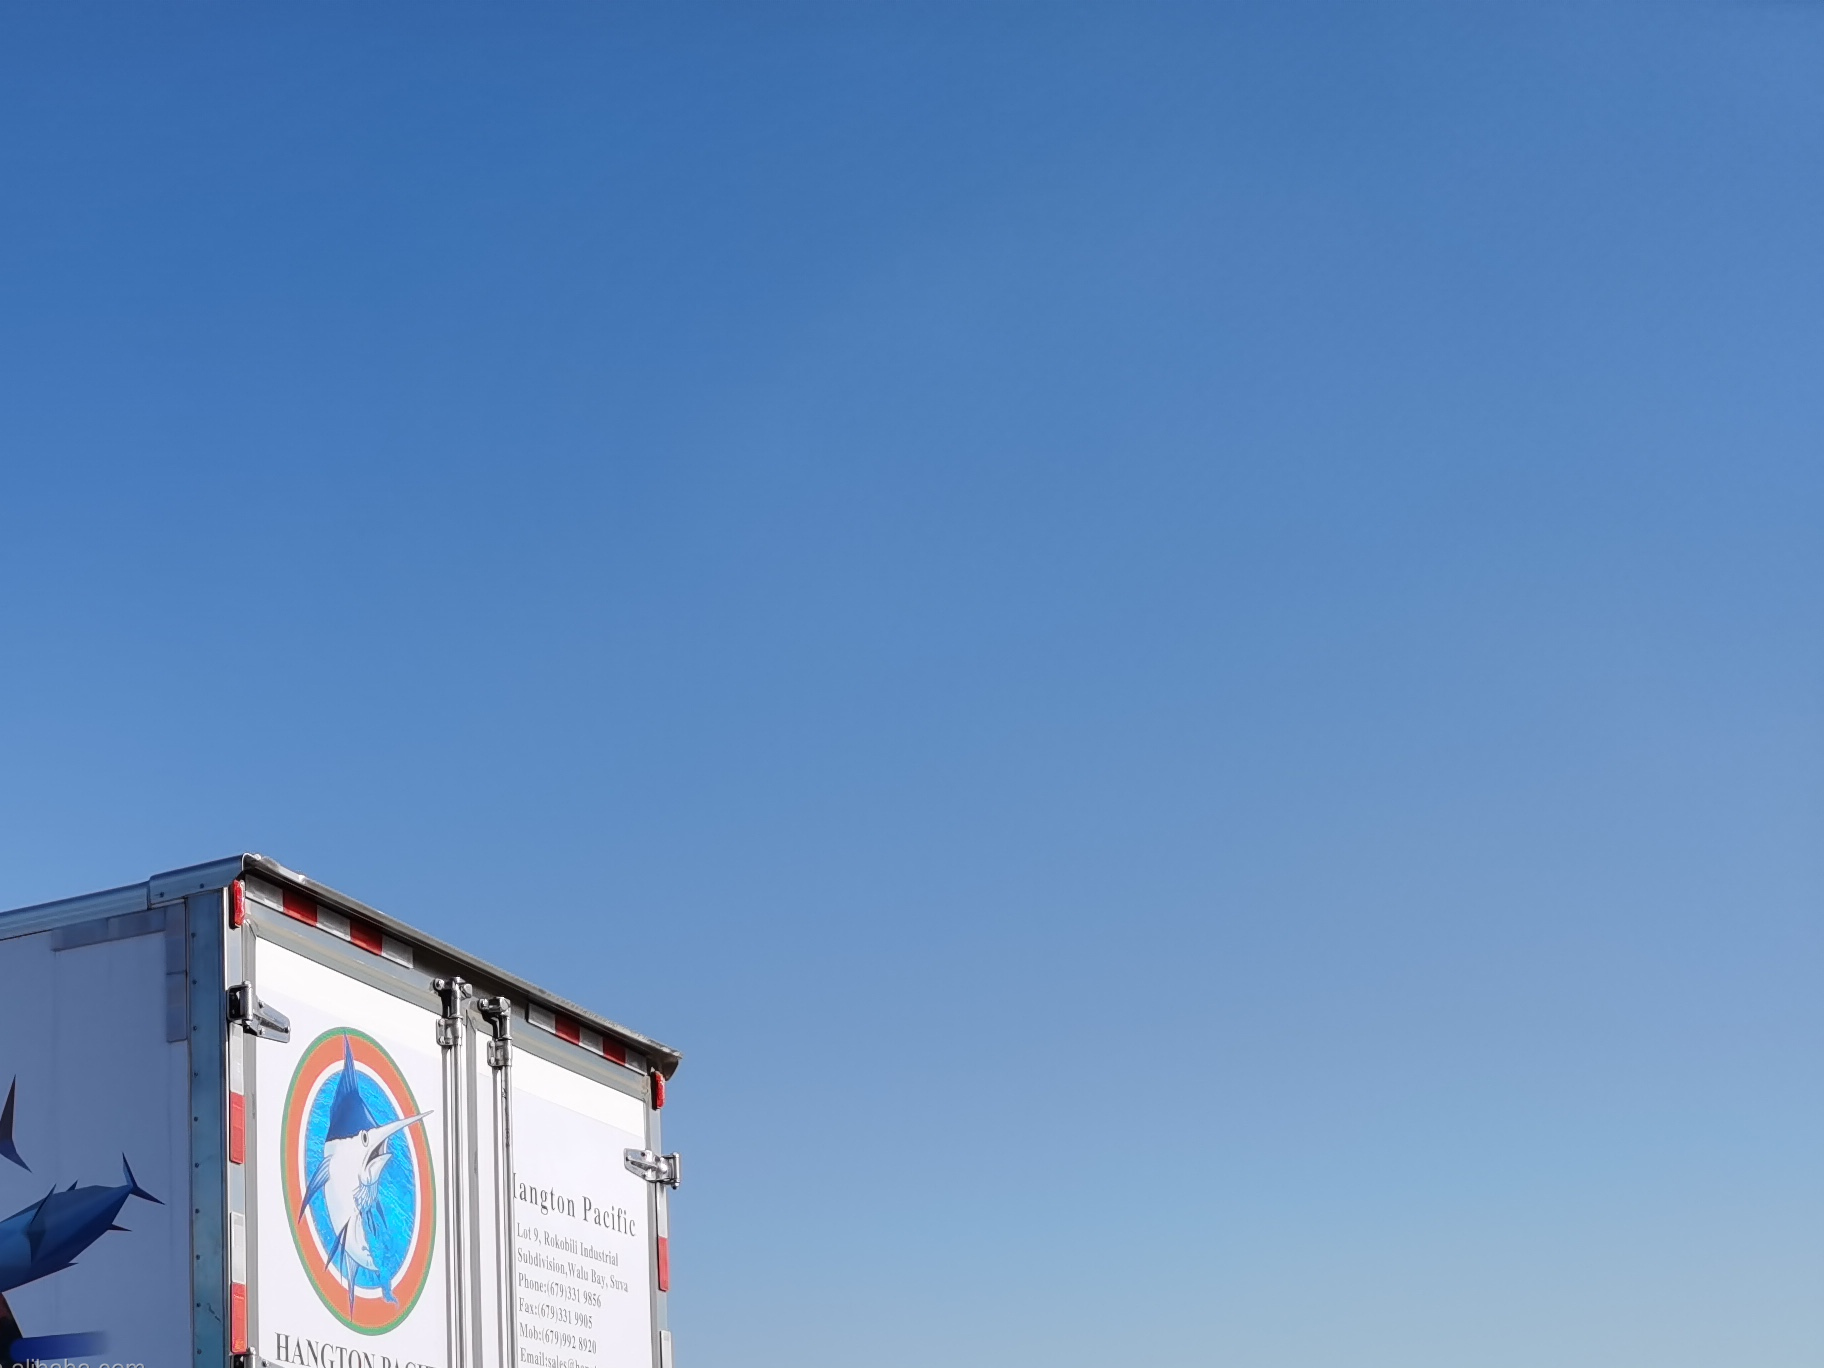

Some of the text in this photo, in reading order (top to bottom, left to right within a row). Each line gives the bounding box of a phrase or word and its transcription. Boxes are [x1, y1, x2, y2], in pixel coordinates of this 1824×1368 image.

[582, 1196, 636, 1236] Pacific
[517, 1222, 619, 1267] Lot 9, Rokobili Industrial
[591, 1269, 608, 1289] Bay,
[610, 1275, 629, 1292] Suva
[583, 1290, 602, 1308] 9856
[574, 1311, 593, 1329] 9905
[578, 1337, 597, 1354] 8920
